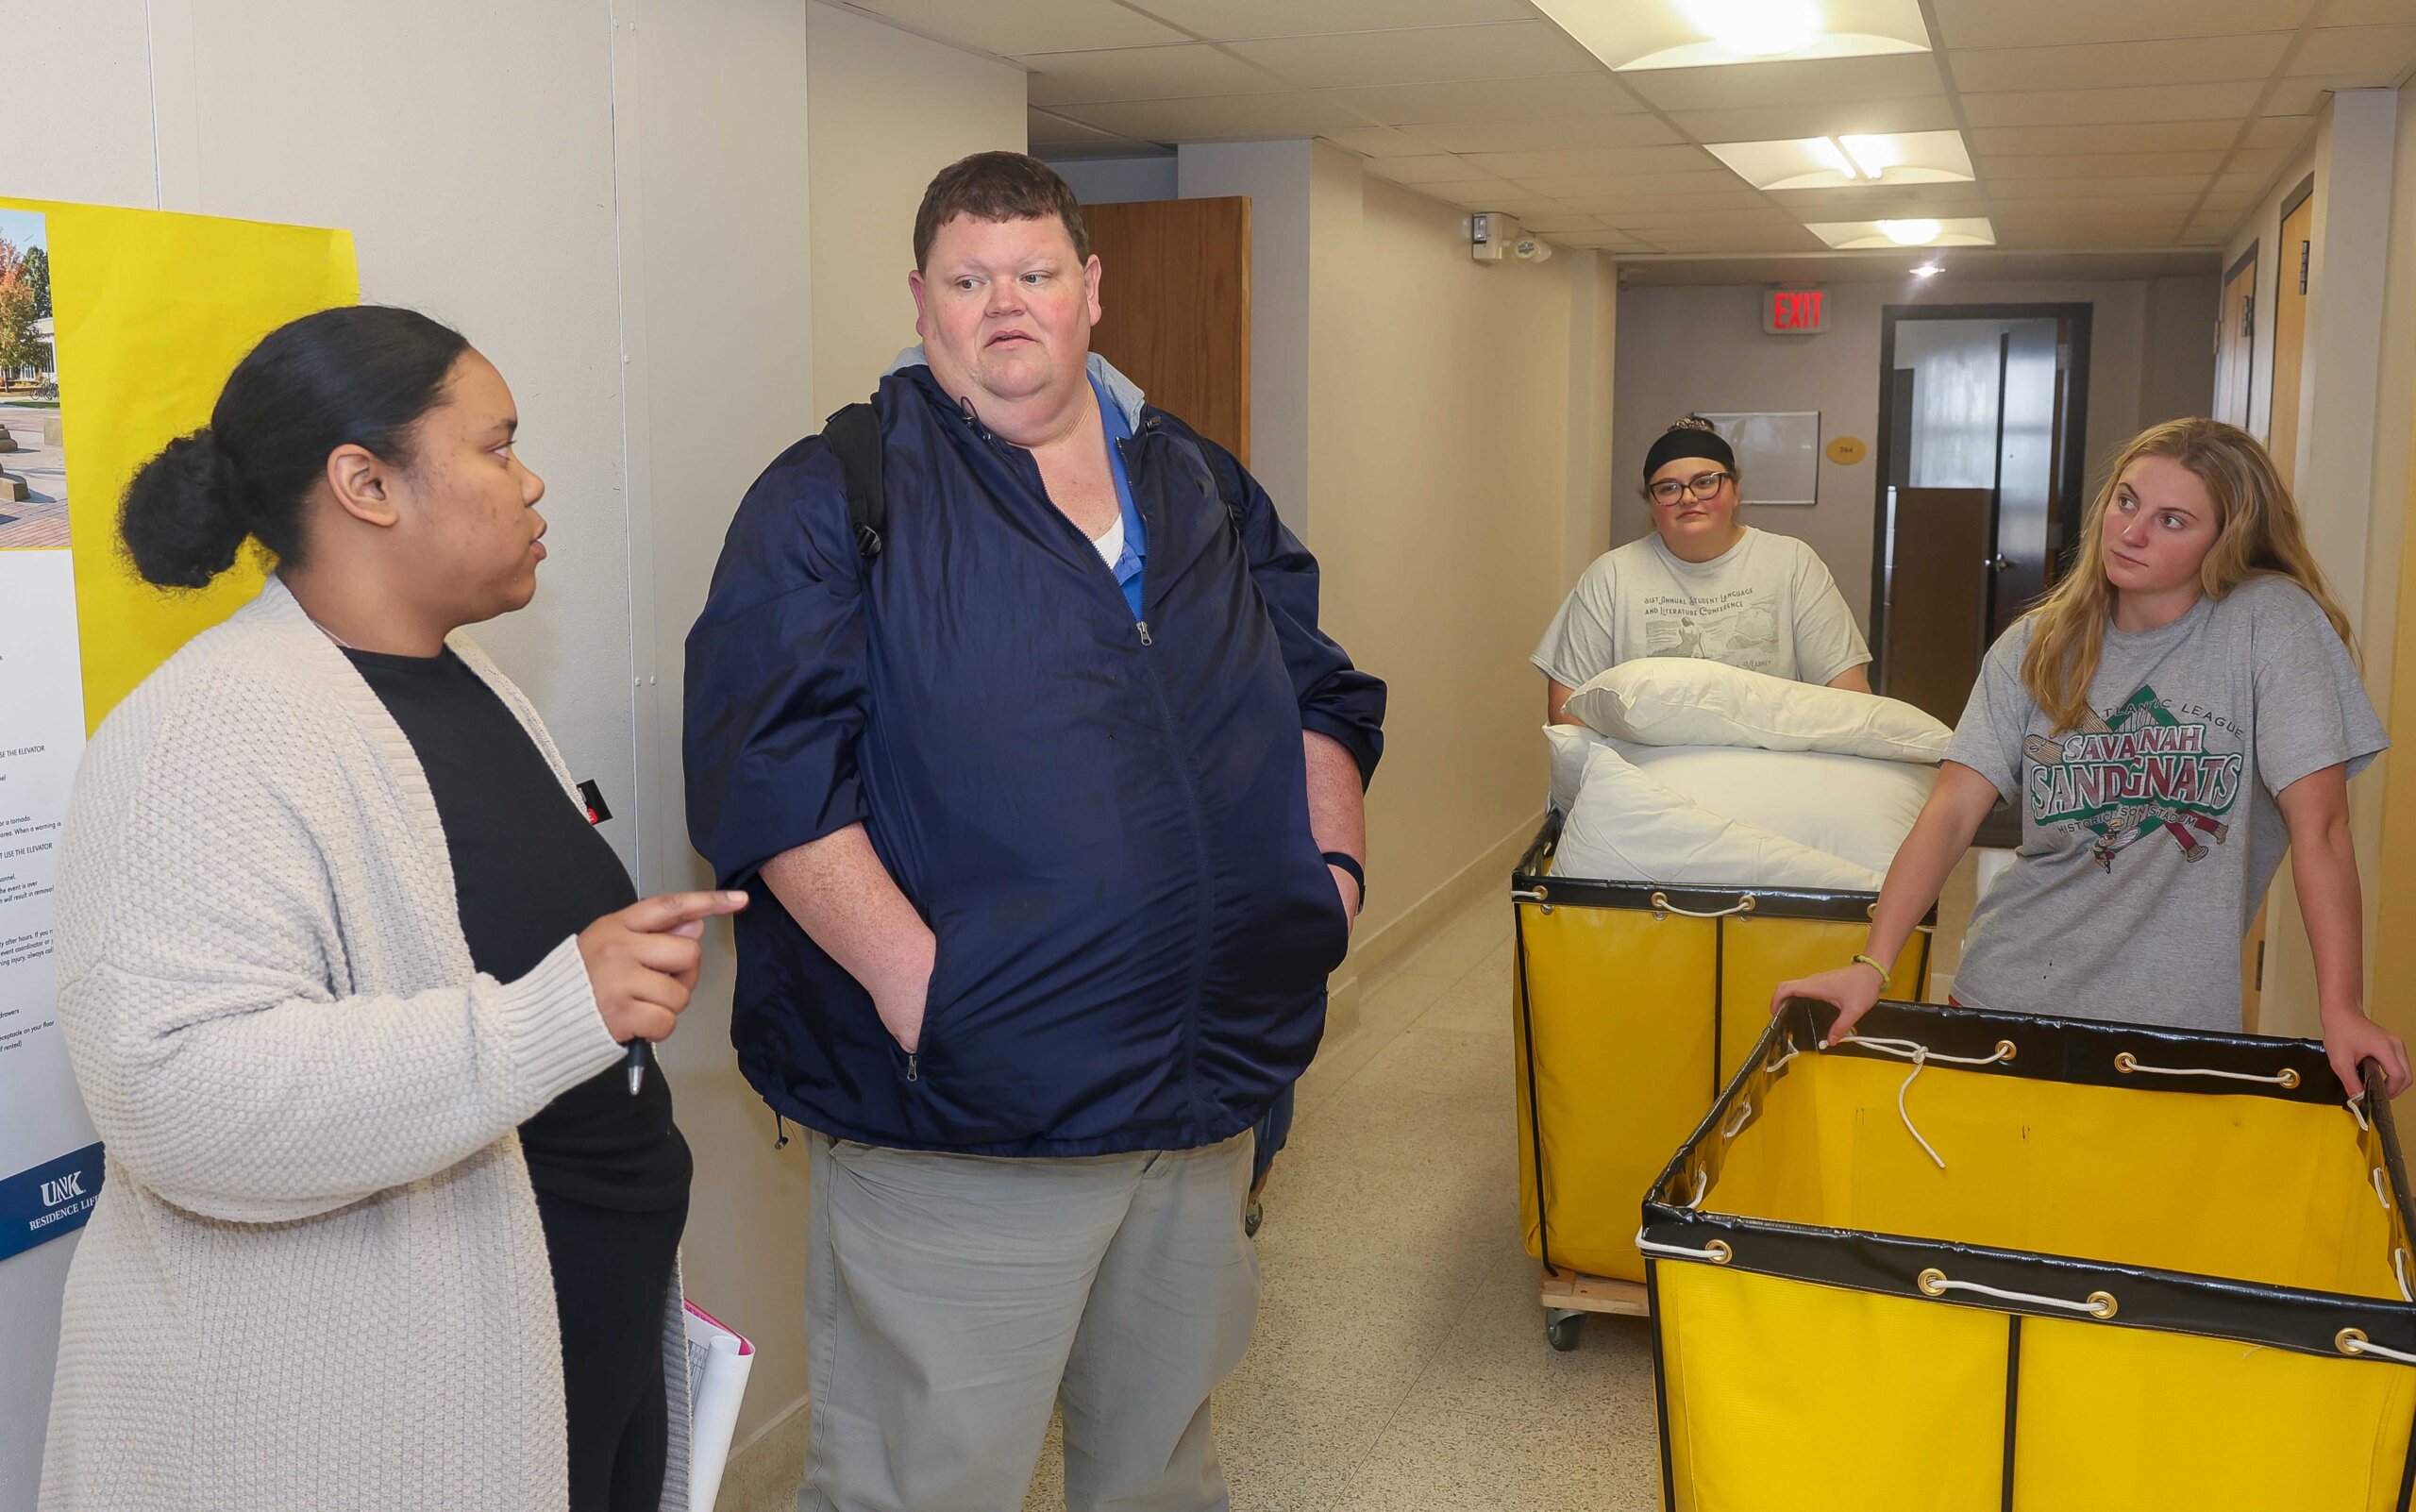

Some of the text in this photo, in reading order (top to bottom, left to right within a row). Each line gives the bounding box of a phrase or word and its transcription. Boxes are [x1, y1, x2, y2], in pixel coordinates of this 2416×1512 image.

[1774, 292, 1824, 329] EXIT
[1689, 596, 1718, 606] STUDENT
[1720, 587, 1753, 603] LANGUAGE
[1699, 601, 1744, 616] CONFERENCE
[2181, 703, 2245, 740] LEAGUE
[18, 745, 45, 755] ELEVATOR
[2057, 813, 2111, 834] HISTORIC
[4, 849, 14, 859] USE
[15, 848, 25, 856] THE
[26, 842, 53, 854] ELEVATOR
[8, 883, 21, 893] event
[34, 885, 54, 896] removal
[1, 948, 14, 957] event
[15, 941, 43, 952] coordinator
[6, 937, 18, 946] after
[27, 950, 44, 959] always
[31, 1024, 42, 1033] your
[40, 1170, 85, 1207] UNK
[29, 1202, 79, 1231] RESIDENCE
